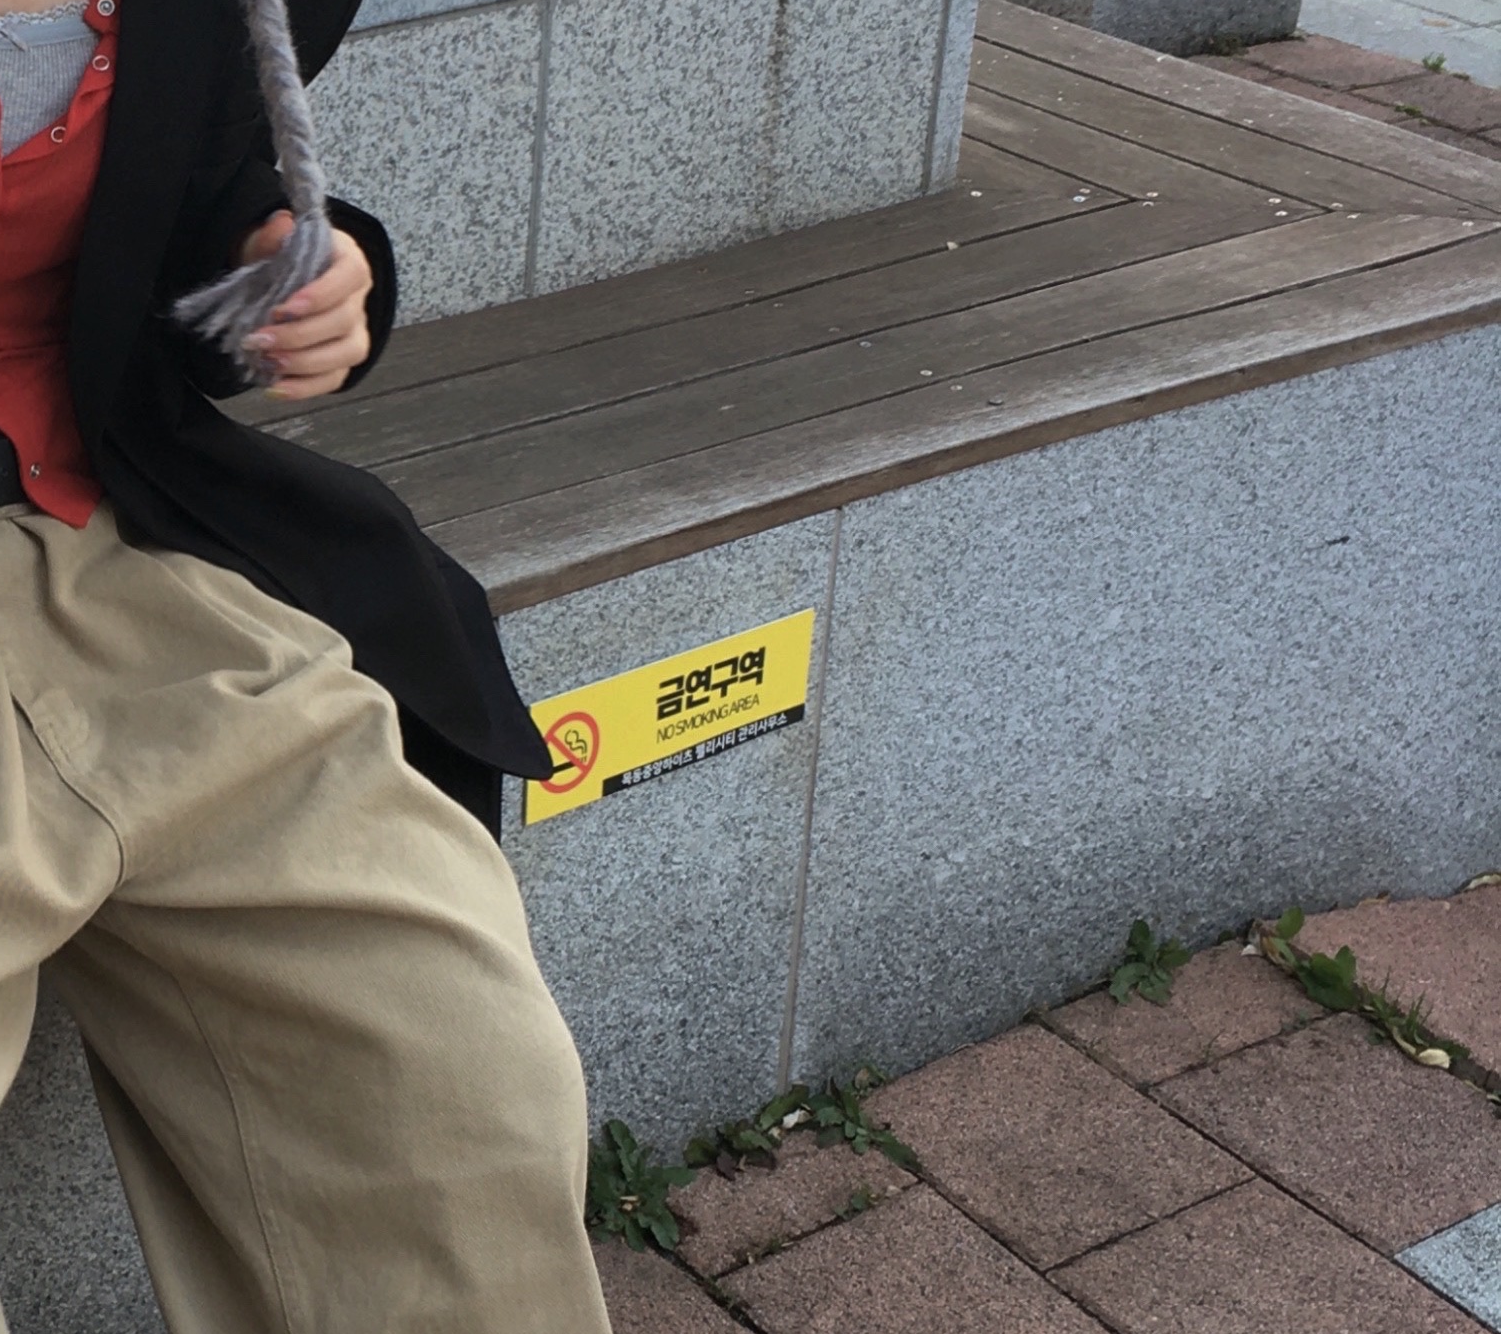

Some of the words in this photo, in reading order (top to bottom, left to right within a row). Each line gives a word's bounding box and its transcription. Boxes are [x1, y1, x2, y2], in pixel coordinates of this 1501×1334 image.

[656, 646, 766, 721] 금연구역
[656, 725, 675, 743] NO
[676, 703, 728, 736] SMOKING
[728, 693, 760, 715] AREA
[737, 712, 788, 742] 관리사무소
